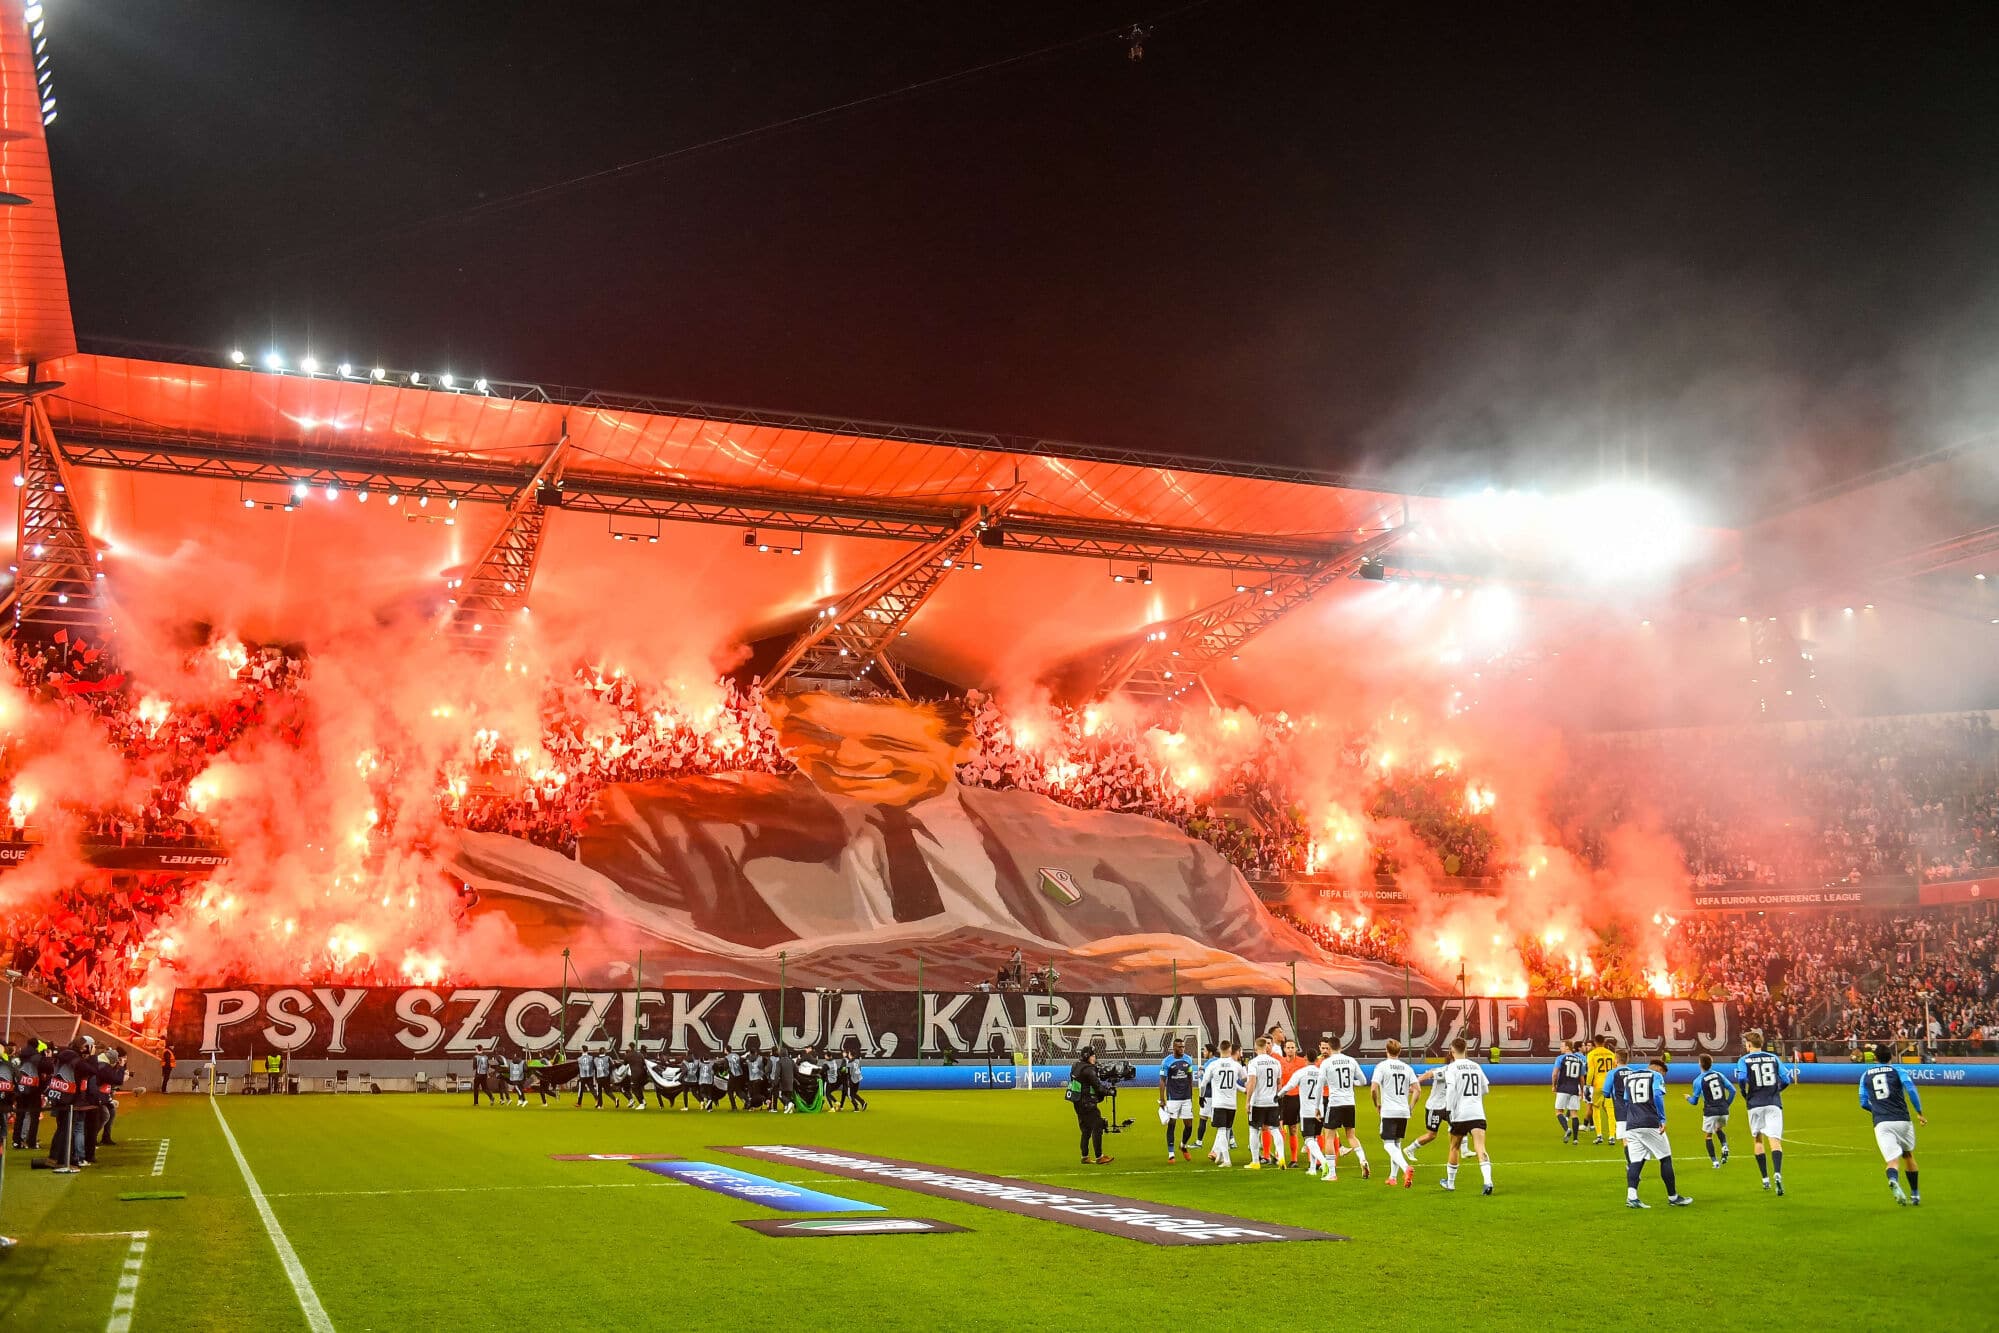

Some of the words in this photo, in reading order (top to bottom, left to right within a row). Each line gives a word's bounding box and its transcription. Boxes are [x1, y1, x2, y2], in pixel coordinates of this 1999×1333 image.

[1319, 889, 1341, 898] UEFA
[1695, 896, 1720, 905] UEFA
[1721, 895, 1758, 905] EUROPA
[1758, 894, 1821, 904] CONFERENCE
[1823, 892, 1861, 902] LEAGUE
[199, 988, 369, 1054] PSY
[920, 992, 1302, 1055] KARAWANA
[1322, 998, 1531, 1053] JEDZIE
[1546, 998, 1729, 1053] DALEJ
[1565, 1060, 1580, 1078] 10
[1597, 1058, 1613, 1073] 20
[1750, 1063, 1776, 1087] 18
[1908, 1069, 1935, 1080] PEACE
[974, 1072, 1011, 1083] PEACE
[1218, 1070, 1234, 1089] 20
[1266, 1068, 1273, 1087] 8
[1335, 1067, 1351, 1088] 13
[1392, 1073, 1406, 1096] 12
[1462, 1073, 1479, 1096] 28
[1872, 1073, 1890, 1100] 9
[1307, 1079, 1318, 1100] 2
[1628, 1078, 1650, 1104] 19
[1709, 1079, 1723, 1100] 6
[1048, 1203, 1275, 1240] LEAGUE
